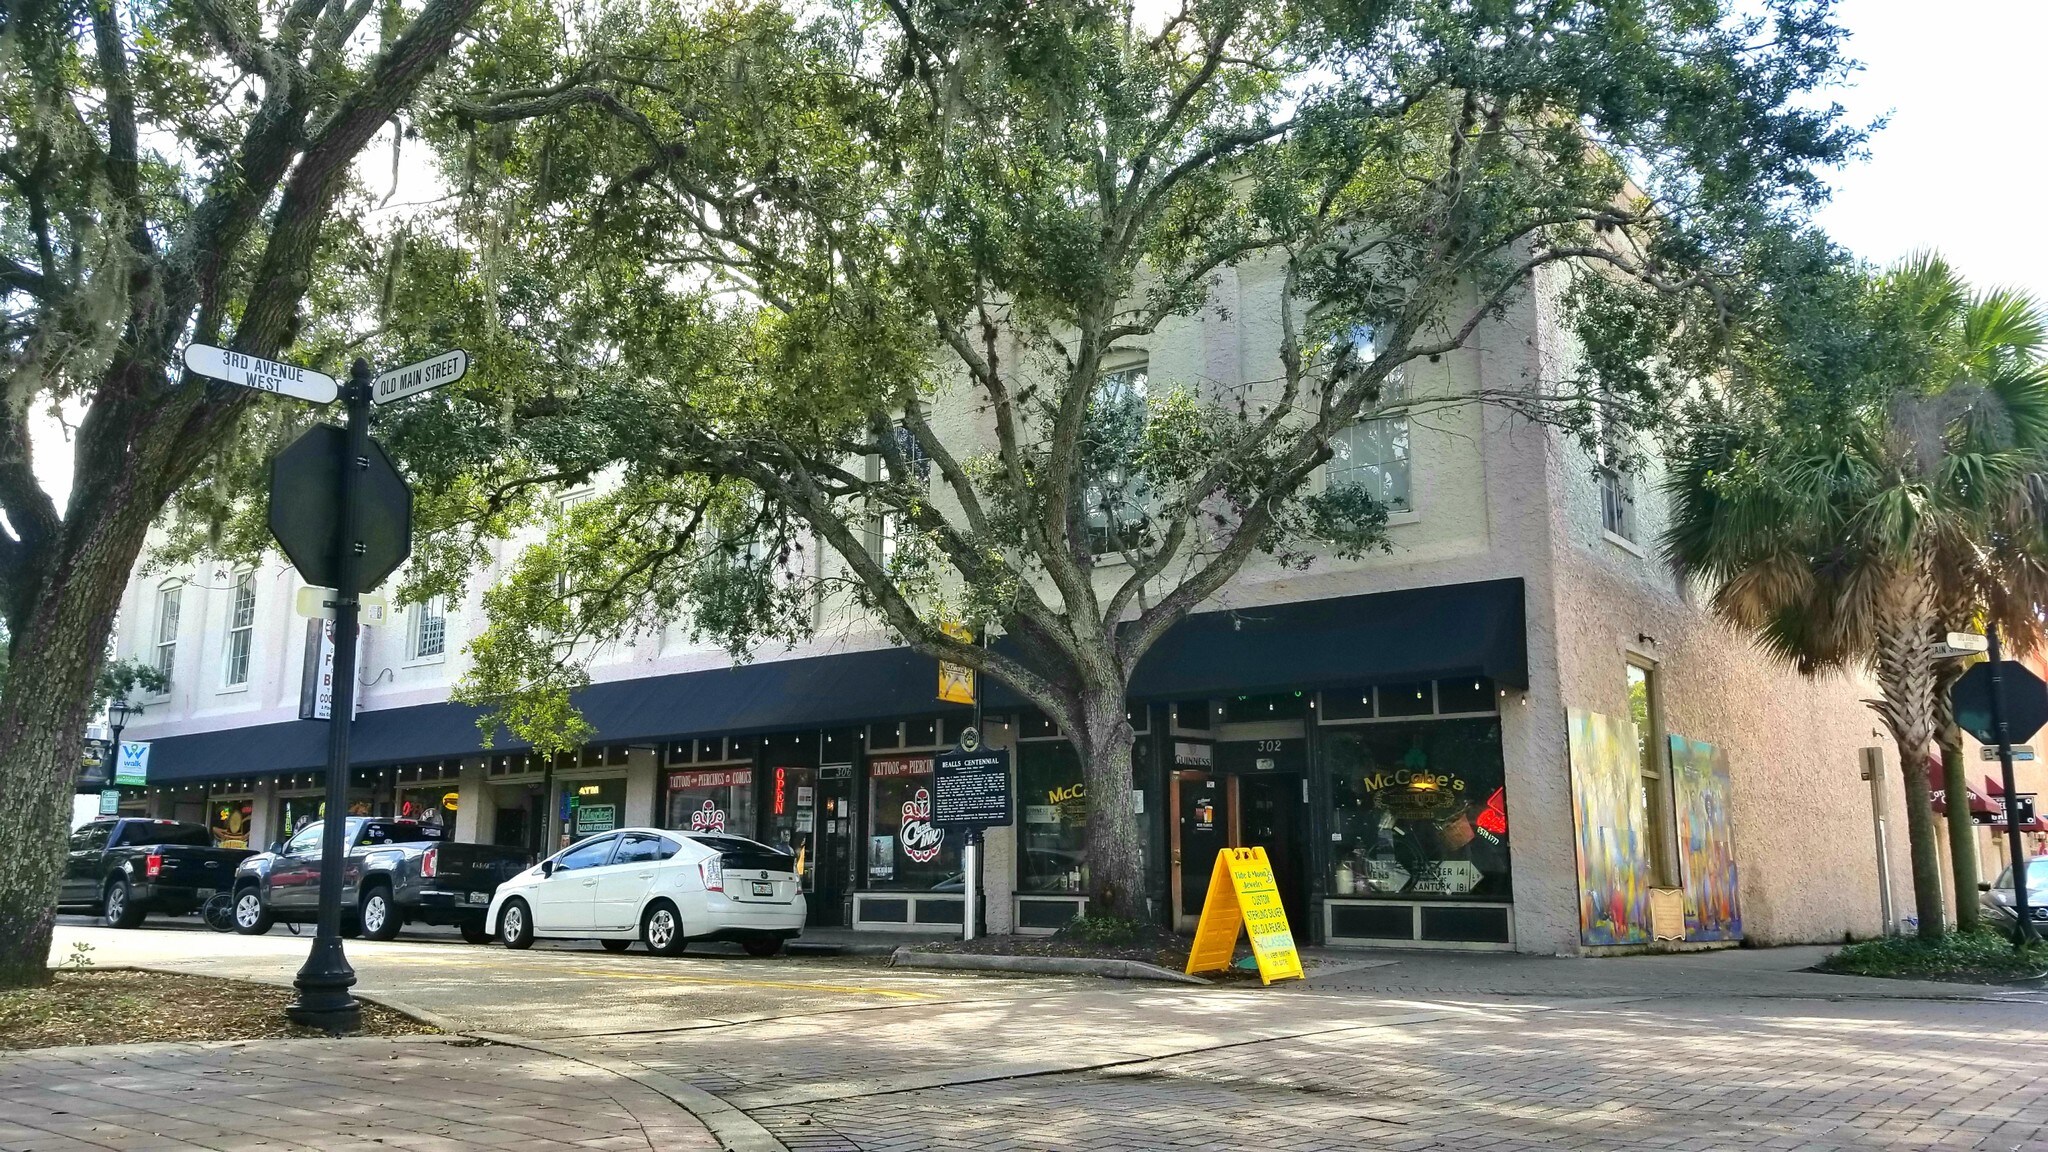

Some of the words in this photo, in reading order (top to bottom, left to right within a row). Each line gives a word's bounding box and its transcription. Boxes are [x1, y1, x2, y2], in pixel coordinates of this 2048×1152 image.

[223, 351, 248, 370] 3RD
[254, 359, 303, 383] AVENUE
[246, 371, 281, 393] WEST
[380, 379, 396, 397] OLD
[400, 369, 421, 389] MAIN
[425, 357, 459, 381] STREET
[1258, 740, 1281, 752] 302
[964, 758, 999, 766] CENTENNIAL
[1175, 754, 1211, 766] GUINNESS
[873, 762, 899, 776] TATTOOS
[910, 760, 935, 774] PIERCIN
[670, 775, 691, 788] TATTOOS
[698, 773, 725, 786] PIERCINGS
[732, 771, 752, 784] COMICS
[1364, 769, 1465, 793] McCabe's
[579, 786, 599, 795] ATM
[775, 768, 786, 814] OPEN
[1413, 882, 1451, 891] KANTURK
[1252, 895, 1270, 905] CUSTOM
[1246, 909, 1269, 920] STERLING
[1268, 907, 1283, 919] SILVER
[1252, 924, 1265, 935] GOLD
[1268, 921, 1287, 933] PEARLS
[1261, 934, 1293, 948] CLASSES
